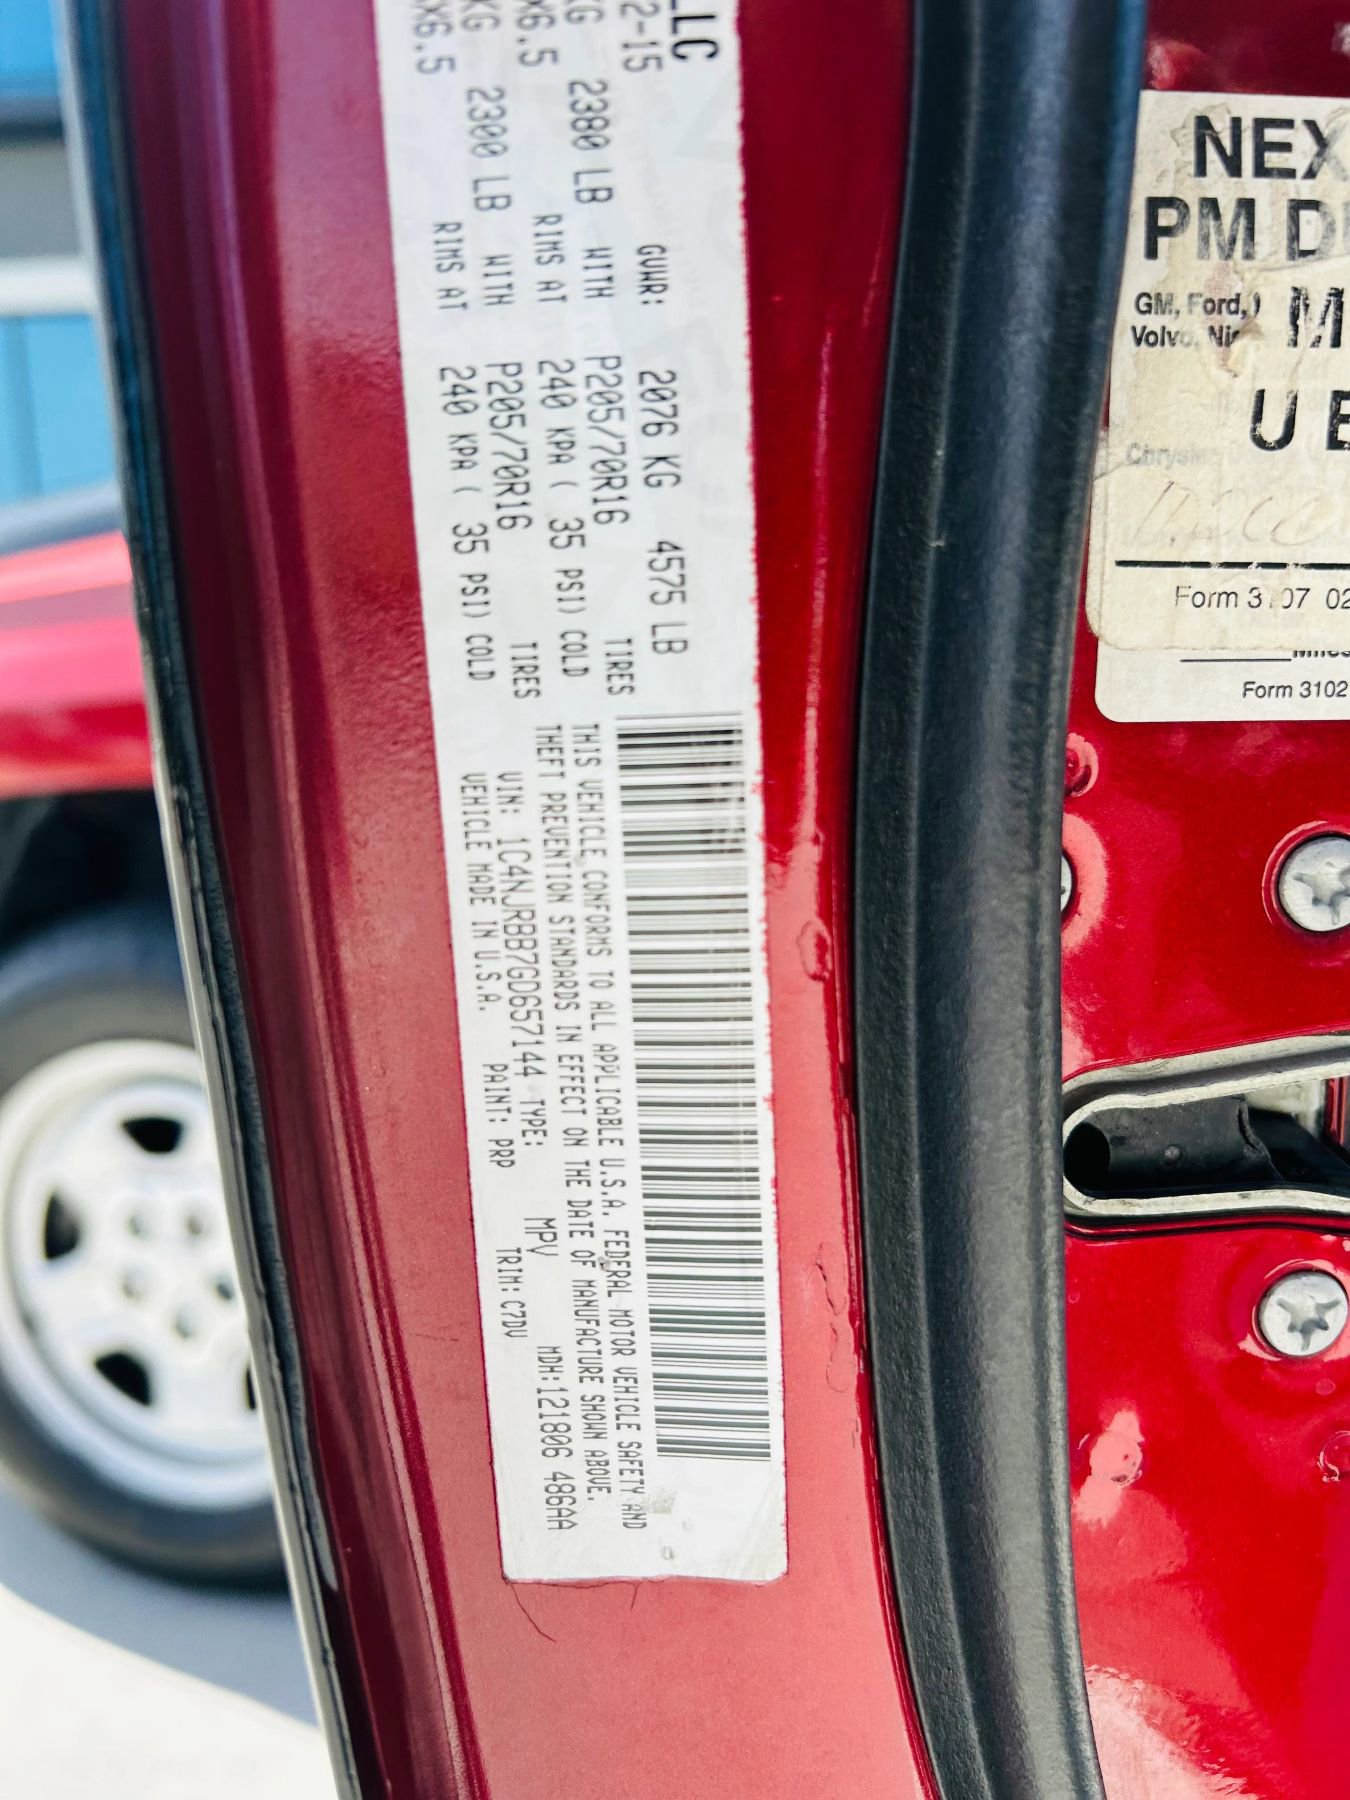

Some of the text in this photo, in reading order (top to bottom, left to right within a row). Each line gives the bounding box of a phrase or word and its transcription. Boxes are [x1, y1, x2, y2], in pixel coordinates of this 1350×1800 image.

[671, 0, 720, 61] LC
[466, 87, 509, 158] 2300
[1193, 115, 1350, 180] NEX
[472, 176, 512, 212] LB
[433, 222, 465, 273] RIMS
[533, 214, 565, 266] RIMS
[1143, 196, 1350, 262] PM D
[437, 289, 469, 310] AT
[481, 254, 514, 307] WITH
[536, 280, 568, 303] AT
[1134, 291, 1180, 318] GM,
[1187, 292, 1247, 319] Ford,
[1287, 286, 1344, 349] M
[563, 0, 634, 696] G 2380 LB WITH P205/70R16 TIRES
[439, 366, 479, 415] 240
[537, 359, 577, 409] 240
[447, 433, 478, 472] KPA
[485, 362, 532, 530] P205/70R16
[545, 427, 576, 465] KPA
[636, 244, 688, 655] GVWR: 2076 KG 4575 LB
[451, 523, 489, 555] 35
[548, 518, 585, 550] 35
[459, 574, 491, 618] PSI)
[555, 569, 587, 614] PSI)
[1176, 586, 1238, 609] Form
[1247, 587, 1311, 609] 307
[465, 634, 495, 681] COLD
[510, 642, 540, 699] TIRES
[559, 630, 590, 677] COLD
[1242, 680, 1349, 699] Form 3102
[496, 772, 524, 814] VIN:
[460, 774, 528, 1338] VEHICLE MADE IN U.S.A. PAINT: PRP TRIM: C7DV
[520, 1100, 547, 1146] TYPE:
[536, 725, 611, 1501] THEFT PREVENTION STANDARDS IN EFFECT ON THE DATE OF MANUFACTURE SHOWN ABOVE.
[572, 724, 647, 1529] THIS VEHICLE CONFORMS TO ALL APPLICABLE U.S.A. FEDERAL MOTOR VEHICLE SAFETY AND
[524, 1217, 558, 1256] MPV
[543, 1472, 578, 1530] 486AA
